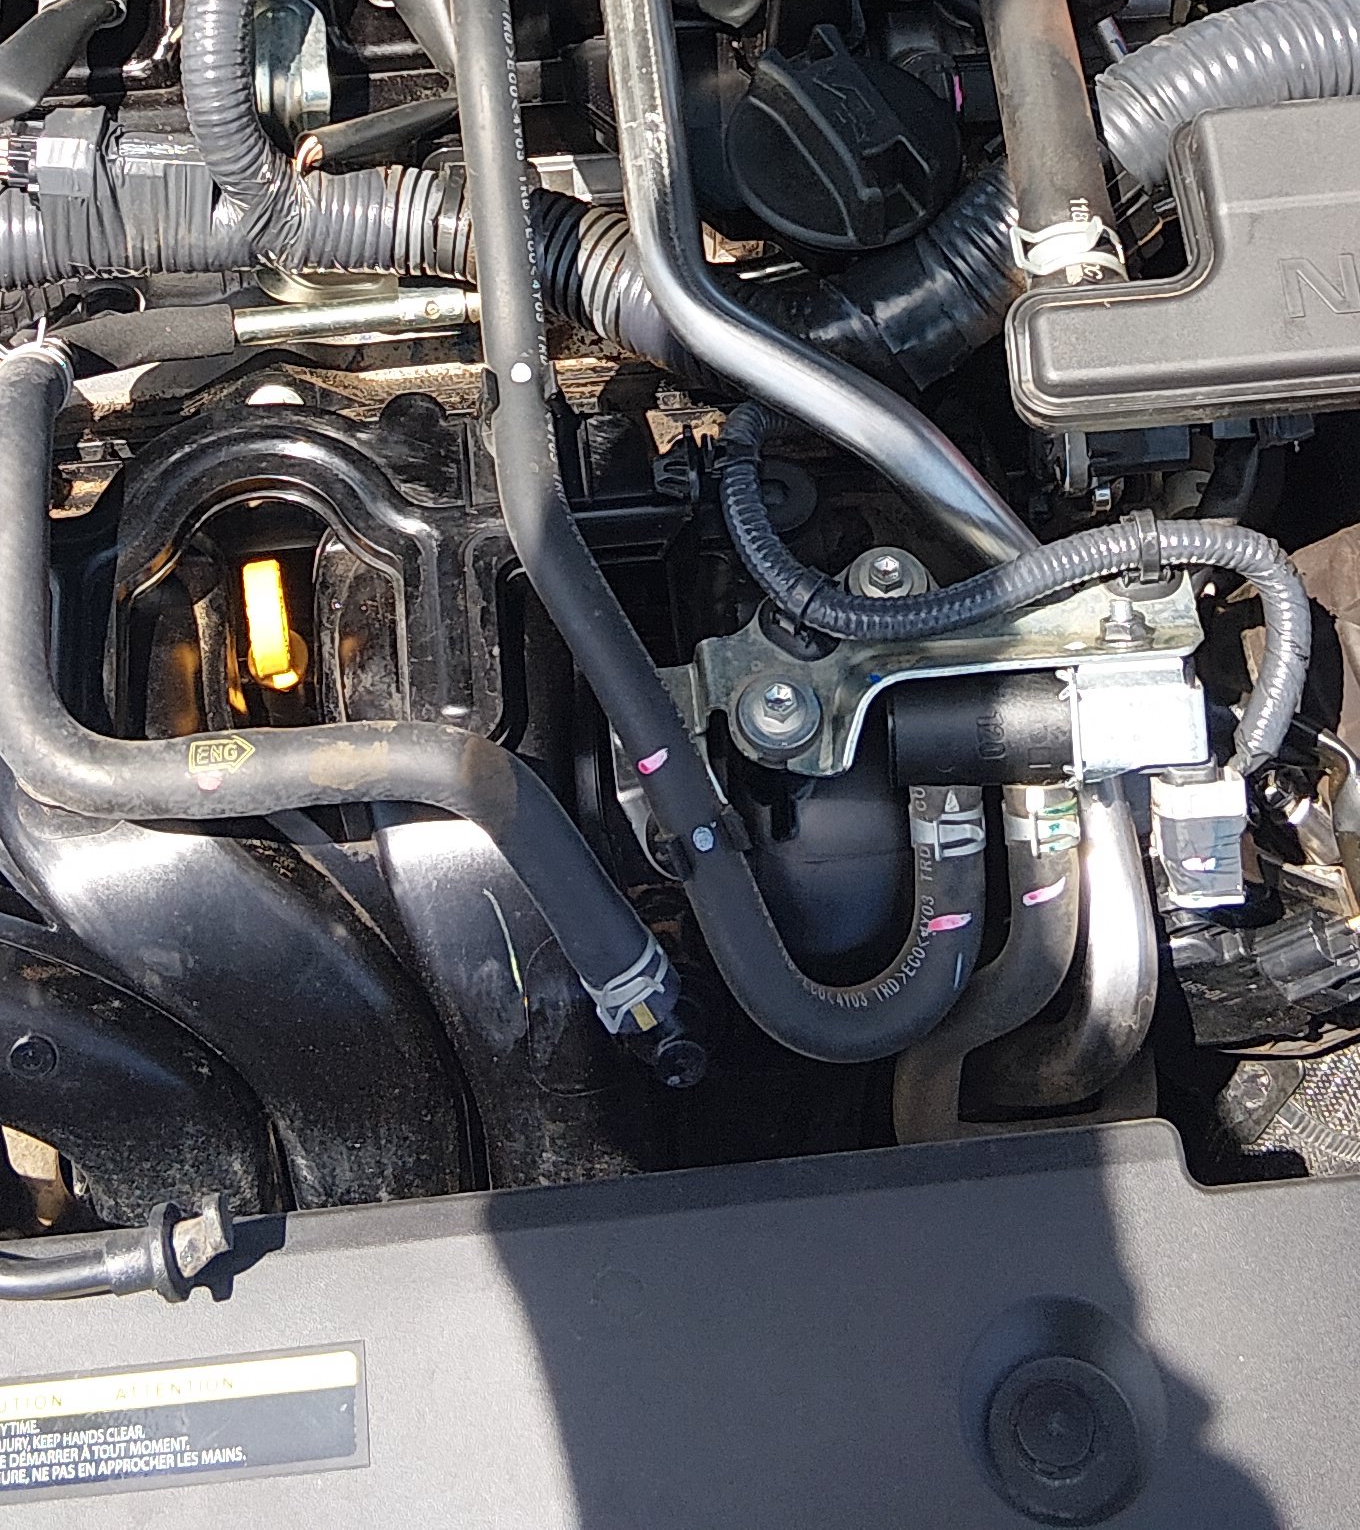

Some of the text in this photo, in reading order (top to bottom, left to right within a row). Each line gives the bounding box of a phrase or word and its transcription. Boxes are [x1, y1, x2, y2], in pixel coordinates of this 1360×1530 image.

[196, 745, 238, 766] ENG
[33, 1433, 61, 1449] KEEP
[62, 1429, 105, 1448] HANDS
[105, 1424, 145, 1443] CLEAR.
[9, 1448, 80, 1468] DÉMARRER
[92, 1441, 128, 1460] TOUT
[129, 1435, 190, 1455] MOMENT.
[32, 1465, 49, 1482] NE
[52, 1463, 76, 1482] PAS
[78, 1461, 96, 1478] EN
[97, 1453, 175, 1476] APPROCHER
[177, 1450, 199, 1467] LES
[201, 1445, 247, 1464] MAINS.
